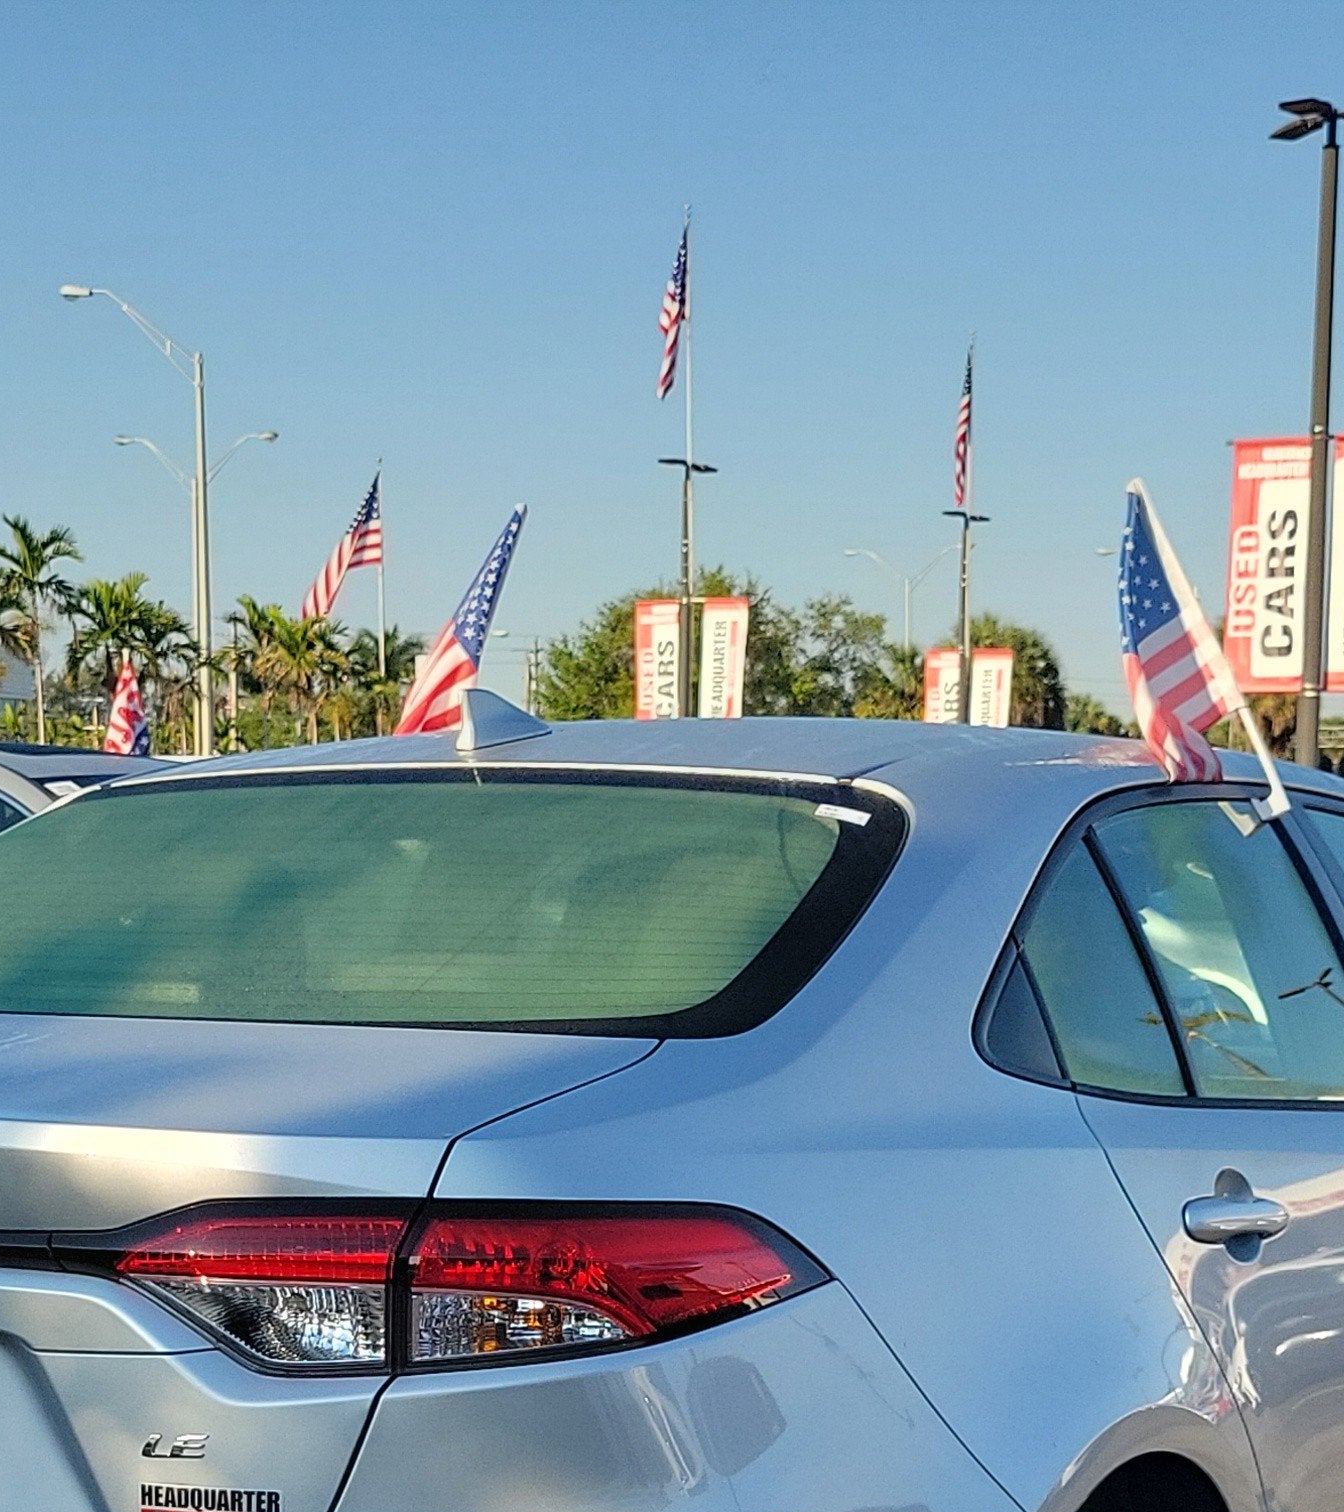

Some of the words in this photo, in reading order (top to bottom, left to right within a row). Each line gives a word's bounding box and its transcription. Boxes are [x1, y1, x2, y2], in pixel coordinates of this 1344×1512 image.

[1232, 530, 1260, 632] USED
[1260, 509, 1298, 658] CARS
[656, 640, 675, 718] CARS
[141, 1432, 210, 1459] LE
